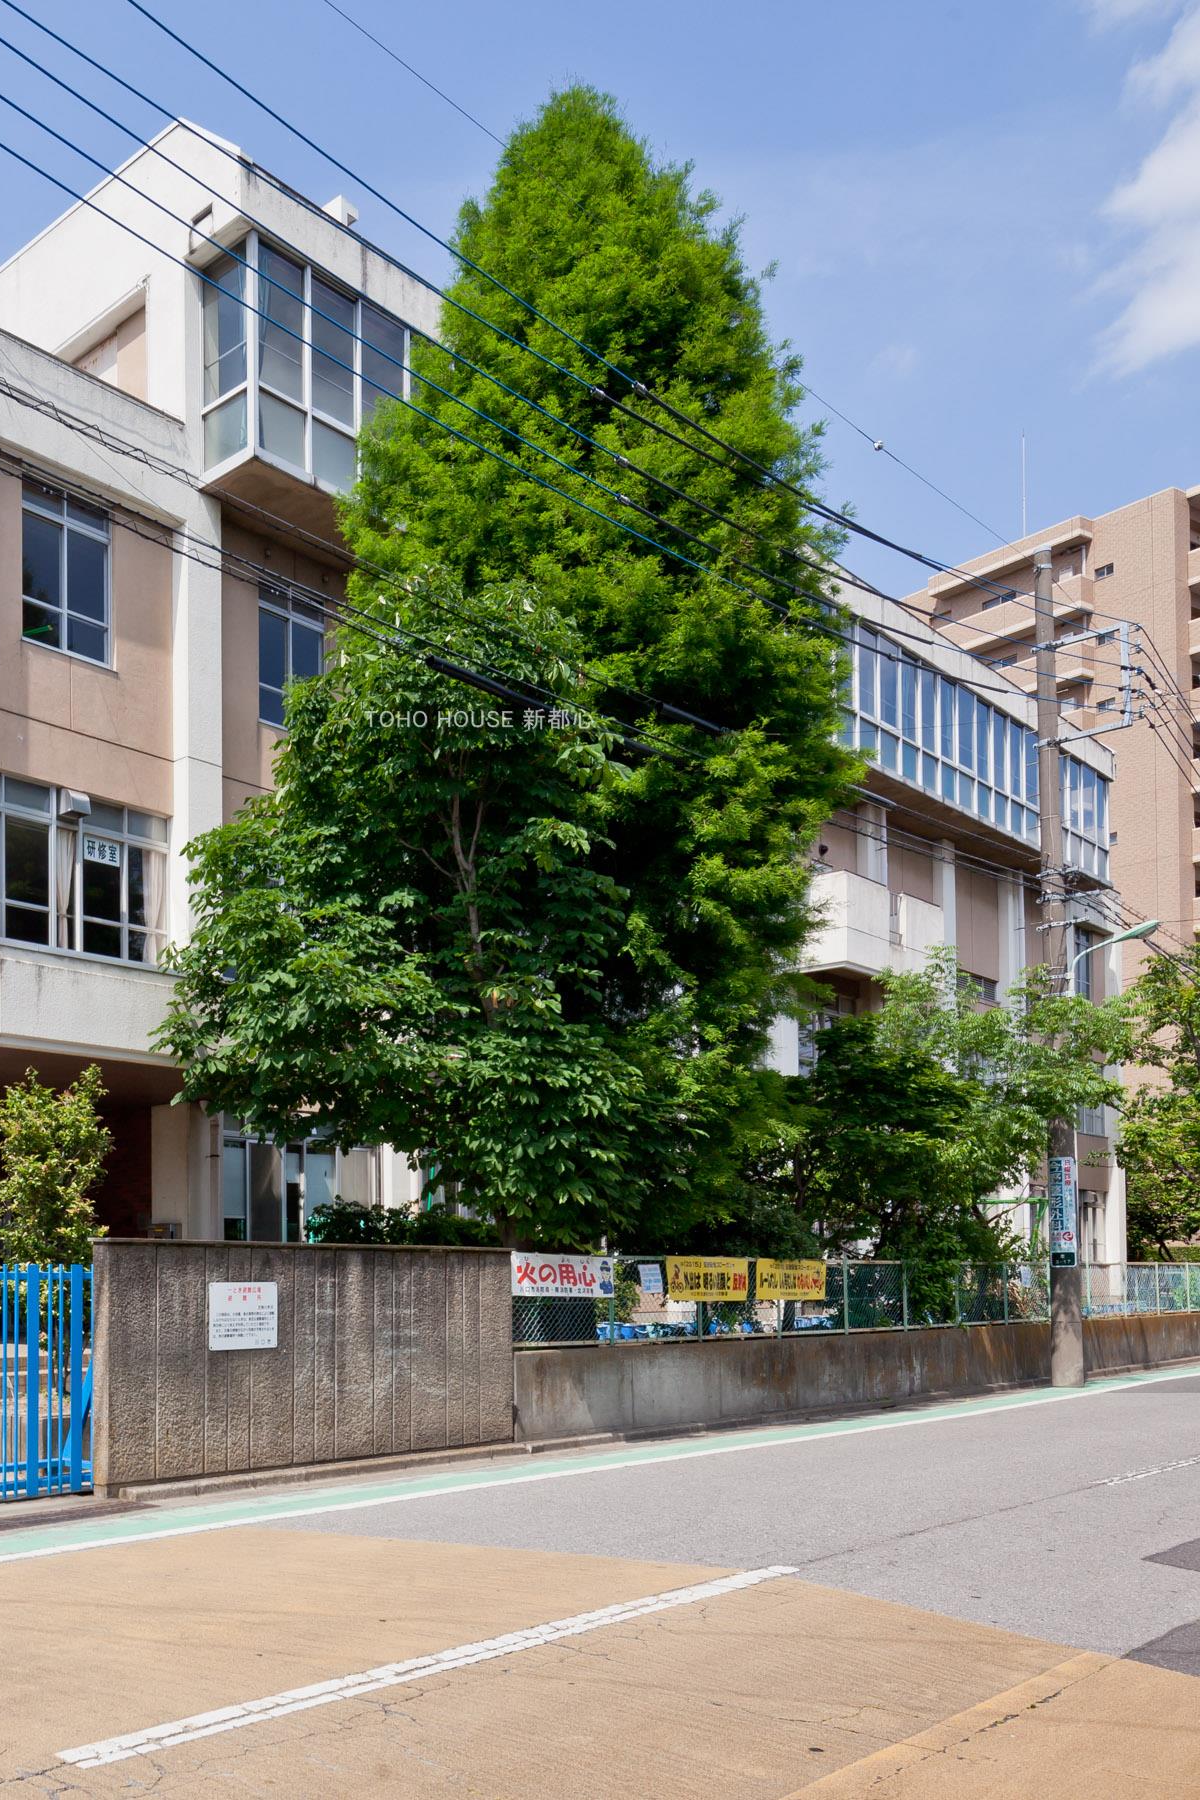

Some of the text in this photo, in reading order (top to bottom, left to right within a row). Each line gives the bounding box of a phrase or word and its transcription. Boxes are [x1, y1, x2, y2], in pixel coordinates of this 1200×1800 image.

[87, 840, 117, 863] 研修室
[517, 1262, 596, 1287] 火の用心
